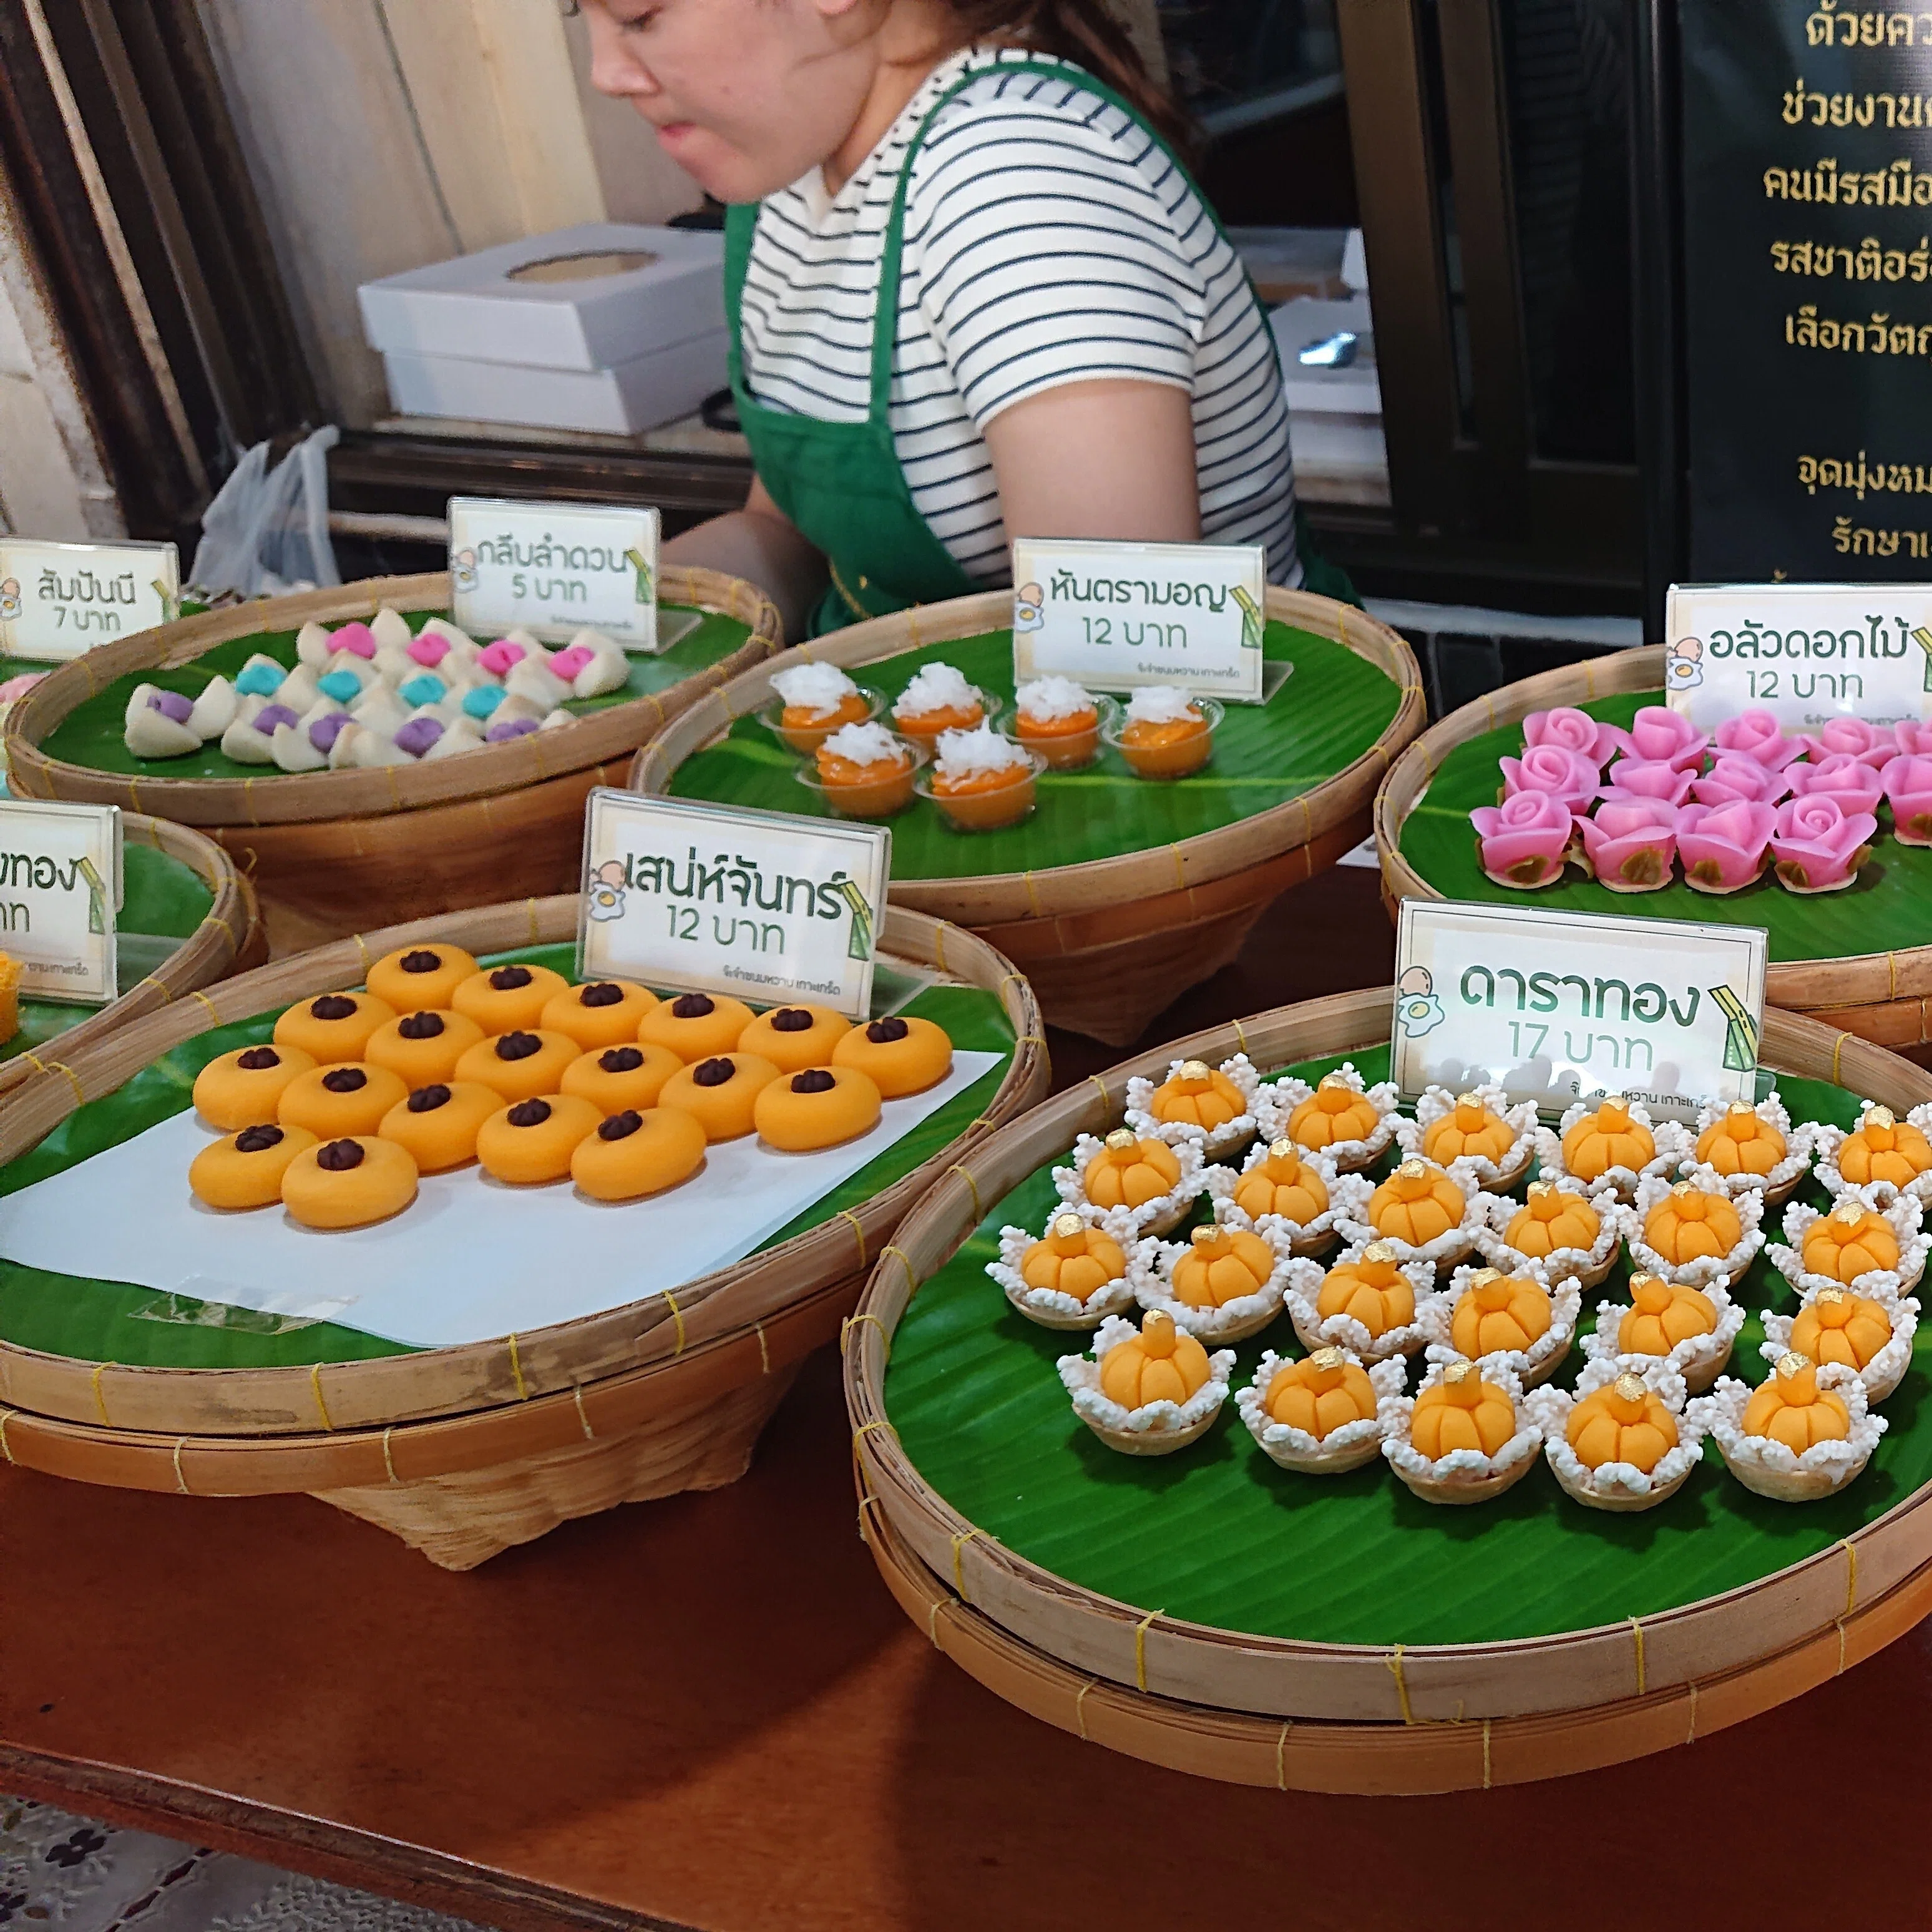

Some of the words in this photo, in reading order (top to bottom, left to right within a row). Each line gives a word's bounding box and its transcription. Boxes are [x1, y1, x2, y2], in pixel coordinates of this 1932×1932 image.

[1770, 235, 1932, 282] รสชาติอร่
[1785, 304, 1932, 356] เลือกวัตถ
[477, 532, 627, 573] กลีบลำดวน
[1832, 515, 1932, 559] รักษาเ
[512, 573, 527, 599] 5
[535, 577, 587, 602] บาท
[1050, 568, 1227, 612] หันตรามอญ
[53, 605, 67, 628] 7
[72, 609, 121, 632] บาท
[1083, 616, 1113, 645] 12
[1123, 621, 1187, 648] บาท
[1709, 615, 1910, 659] อลัวดอกไม้
[1746, 670, 1779, 699] 12
[1792, 673, 1863, 700] บาท
[624, 846, 847, 920] เสน่ห์จันทร์
[666, 904, 700, 941] 12
[713, 914, 786, 955] บาท
[1460, 965, 1701, 1028] ดาราทอง
[1508, 1021, 1550, 1059] 17
[1564, 1031, 1653, 1072] บาท
